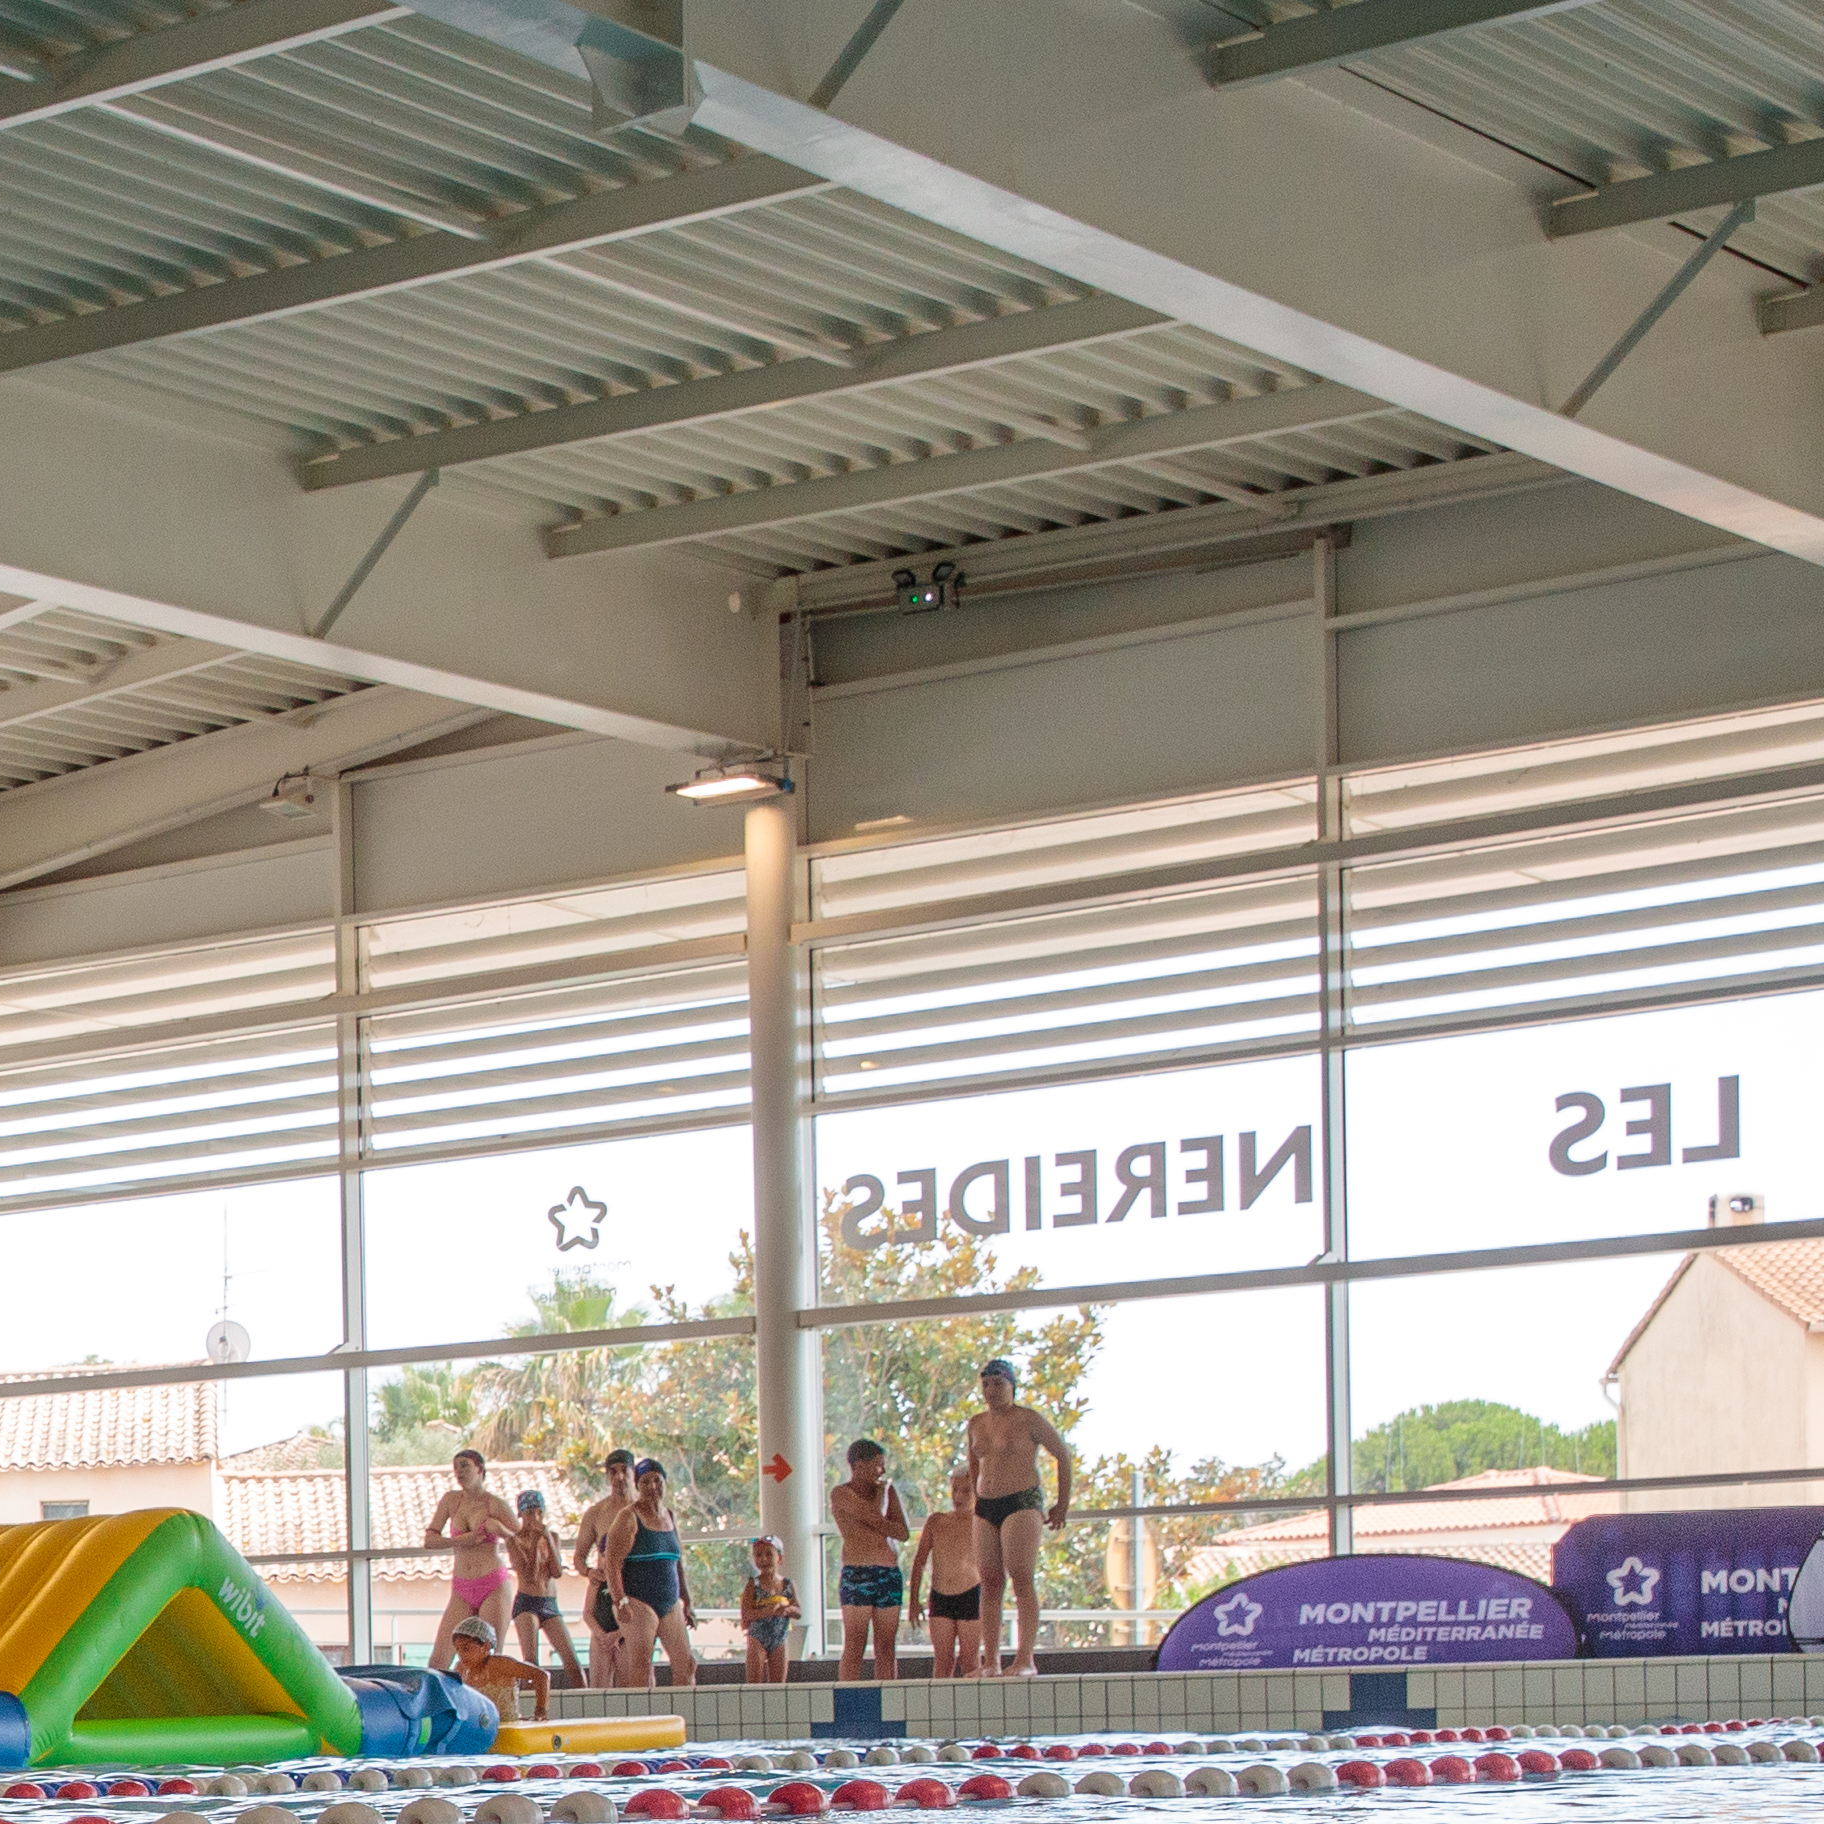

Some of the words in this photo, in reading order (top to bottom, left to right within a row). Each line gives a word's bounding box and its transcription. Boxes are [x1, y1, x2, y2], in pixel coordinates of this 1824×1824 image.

[218, 1576, 266, 1638] wibit
[1299, 1597, 1534, 1626] MONTPELLIER
[1367, 1621, 1545, 1643] MÉDITERRANÉE
[1293, 1644, 1428, 1664] MÉTROPOLE
